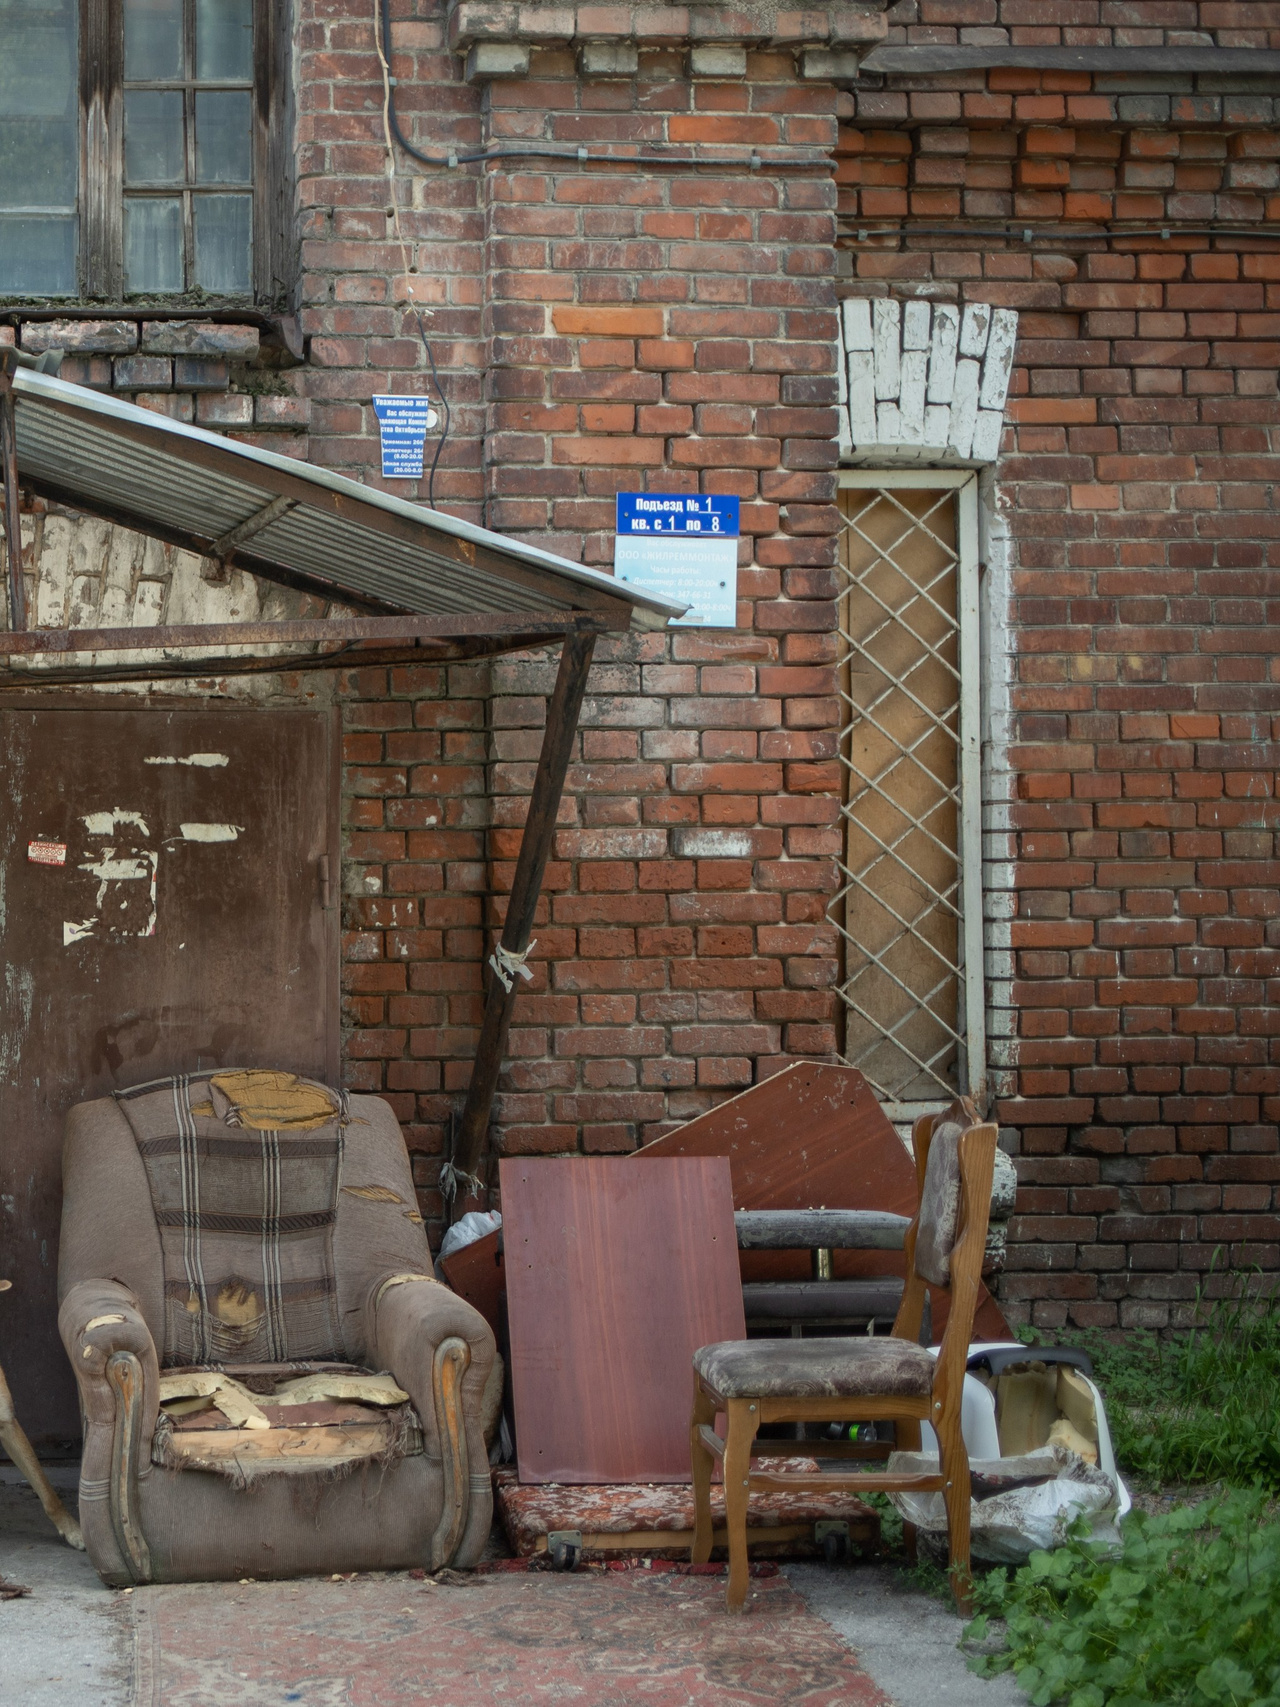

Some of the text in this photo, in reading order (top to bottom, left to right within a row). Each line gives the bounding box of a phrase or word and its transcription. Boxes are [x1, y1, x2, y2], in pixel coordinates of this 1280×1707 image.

[636, 496, 712, 513] Подъезд № 1
[631, 515, 720, 532] кв. с 1 по 8
[618, 550, 640, 560] ООО
[651, 565, 670, 573] Часы
